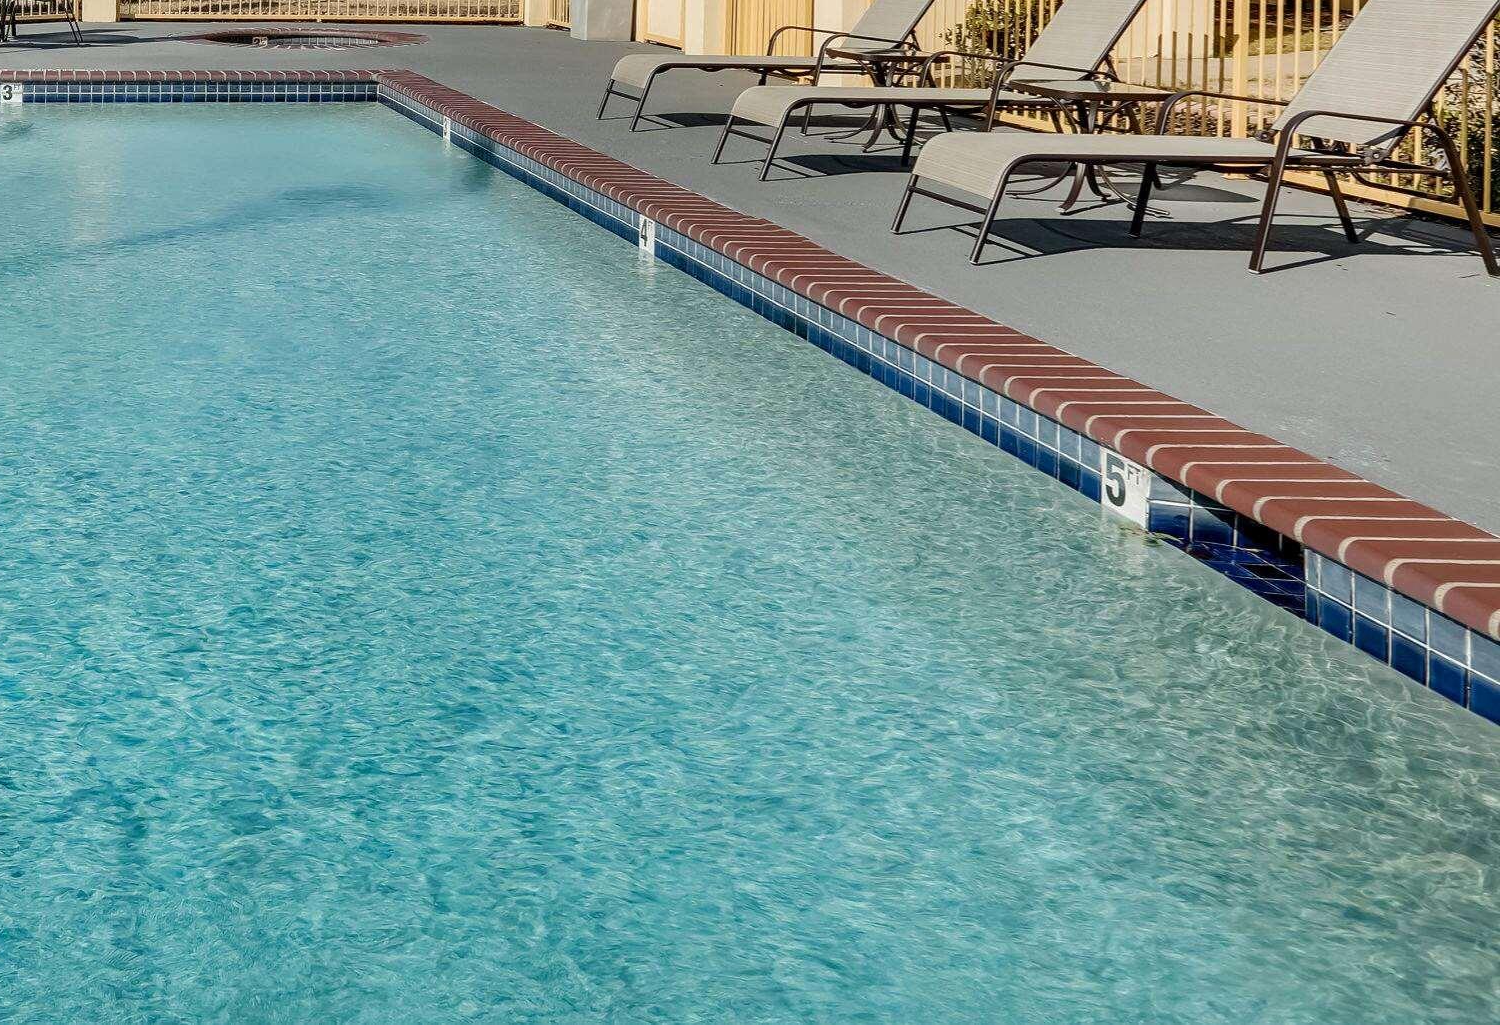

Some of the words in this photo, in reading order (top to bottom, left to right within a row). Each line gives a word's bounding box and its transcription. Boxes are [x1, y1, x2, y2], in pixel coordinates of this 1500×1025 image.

[2, 84, 13, 101] 3
[640, 218, 648, 248] 4
[1105, 452, 1127, 507] 5
[1127, 463, 1142, 486] FT
